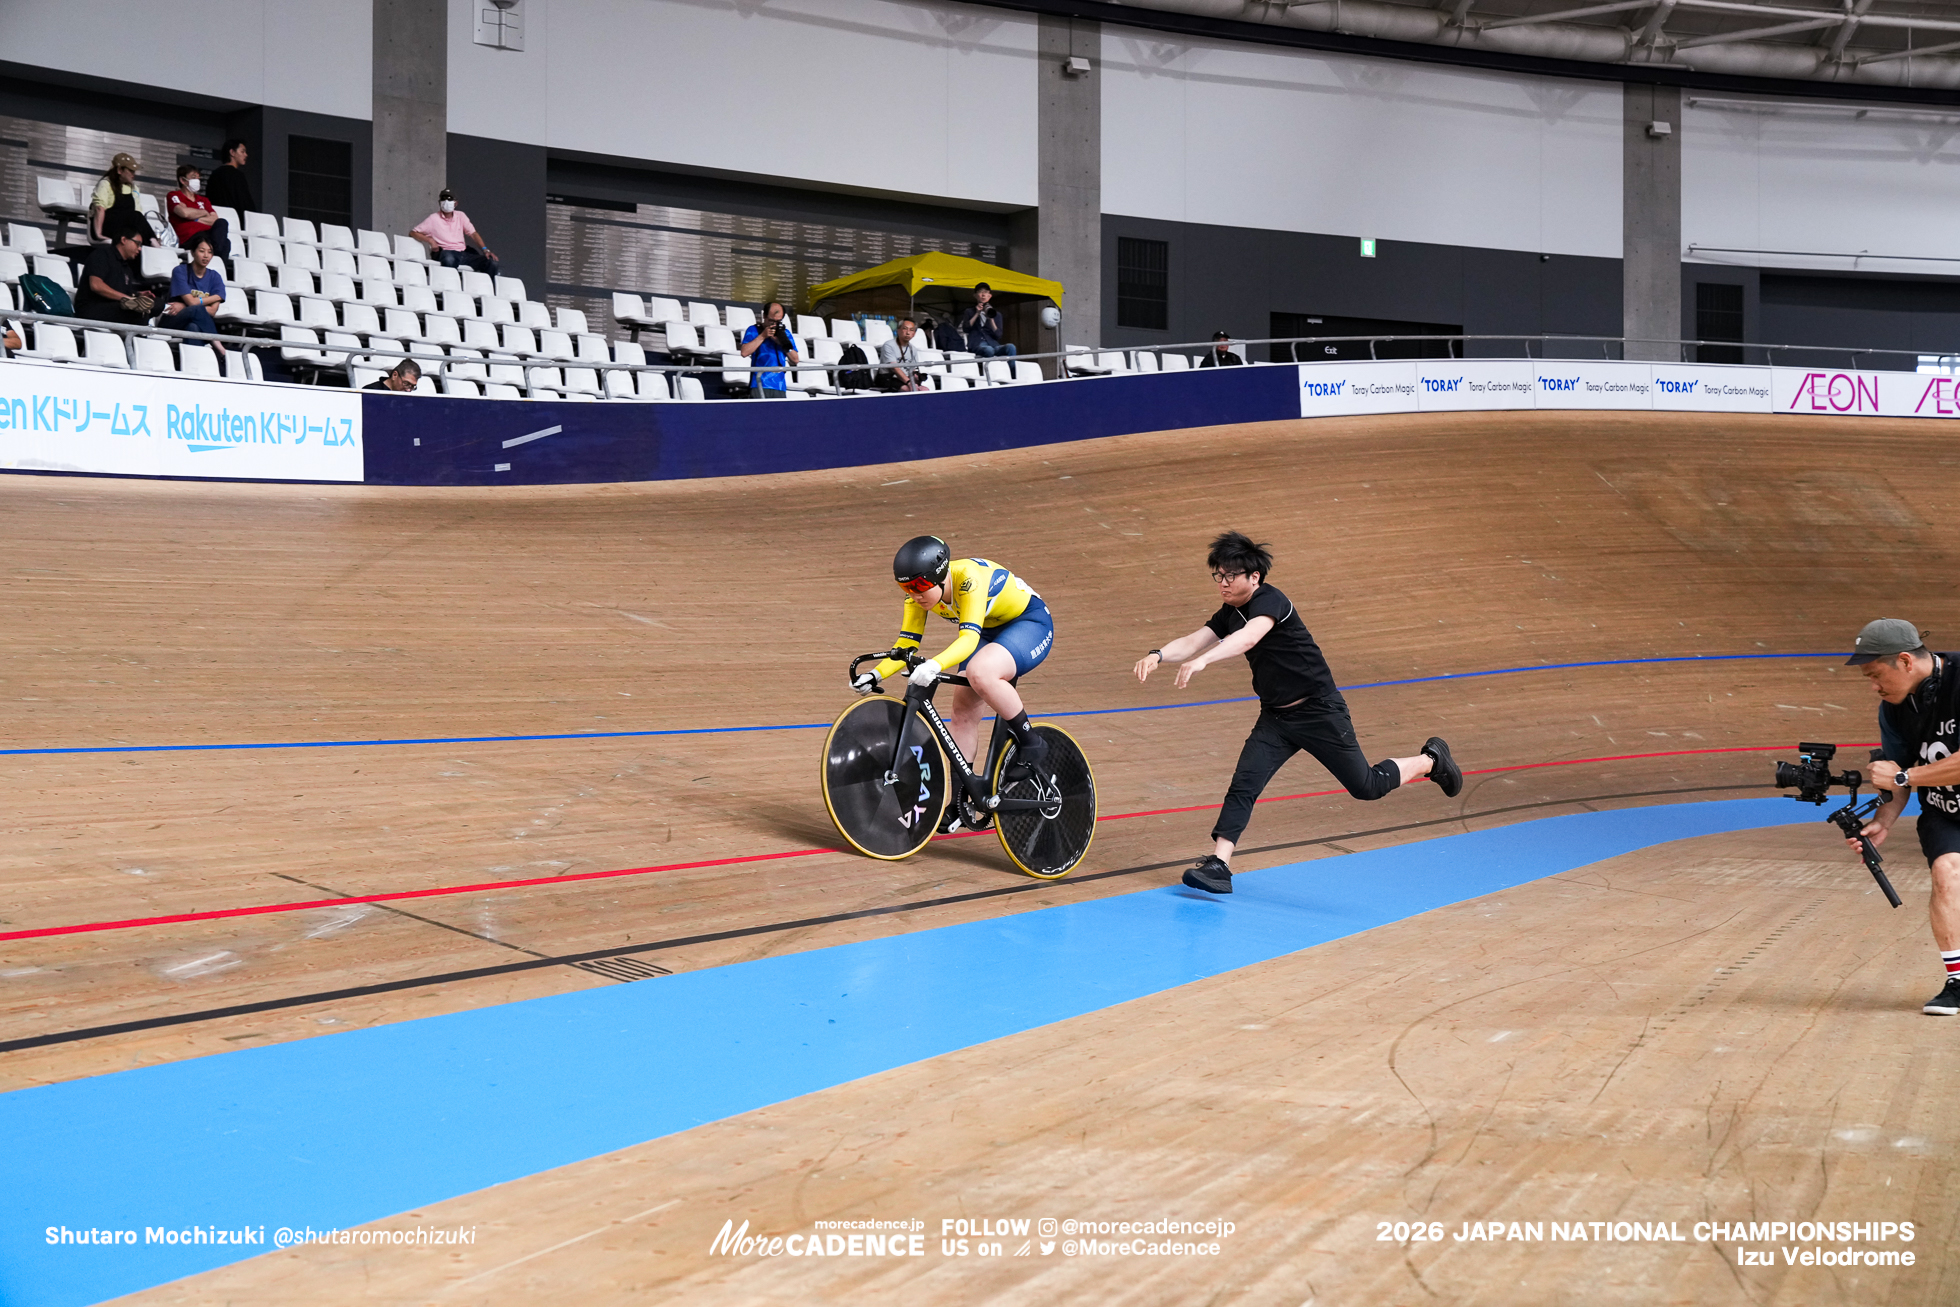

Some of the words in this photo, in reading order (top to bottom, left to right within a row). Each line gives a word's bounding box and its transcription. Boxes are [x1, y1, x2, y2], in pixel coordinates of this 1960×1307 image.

[1351, 384, 1369, 396] Toray
[1370, 383, 1394, 395] Carbon
[1395, 384, 1415, 396] Magic
[1468, 381, 1487, 394] Toray
[1487, 380, 1511, 392] Carbon
[1512, 382, 1532, 393] Magic
[1585, 381, 1604, 394] Toray
[1604, 380, 1628, 392] Carbon
[1629, 383, 1649, 395] Magic
[1704, 384, 1722, 396] Toray
[1723, 385, 1748, 396] Carbon
[1749, 387, 1769, 398] Magic
[32, 395, 151, 437] Kドリームス
[166, 403, 257, 443] Rakuten
[260, 411, 355, 448] Kドリームス
[1936, 719, 1957, 736] JCF
[897, 745, 931, 829] ARAYA
